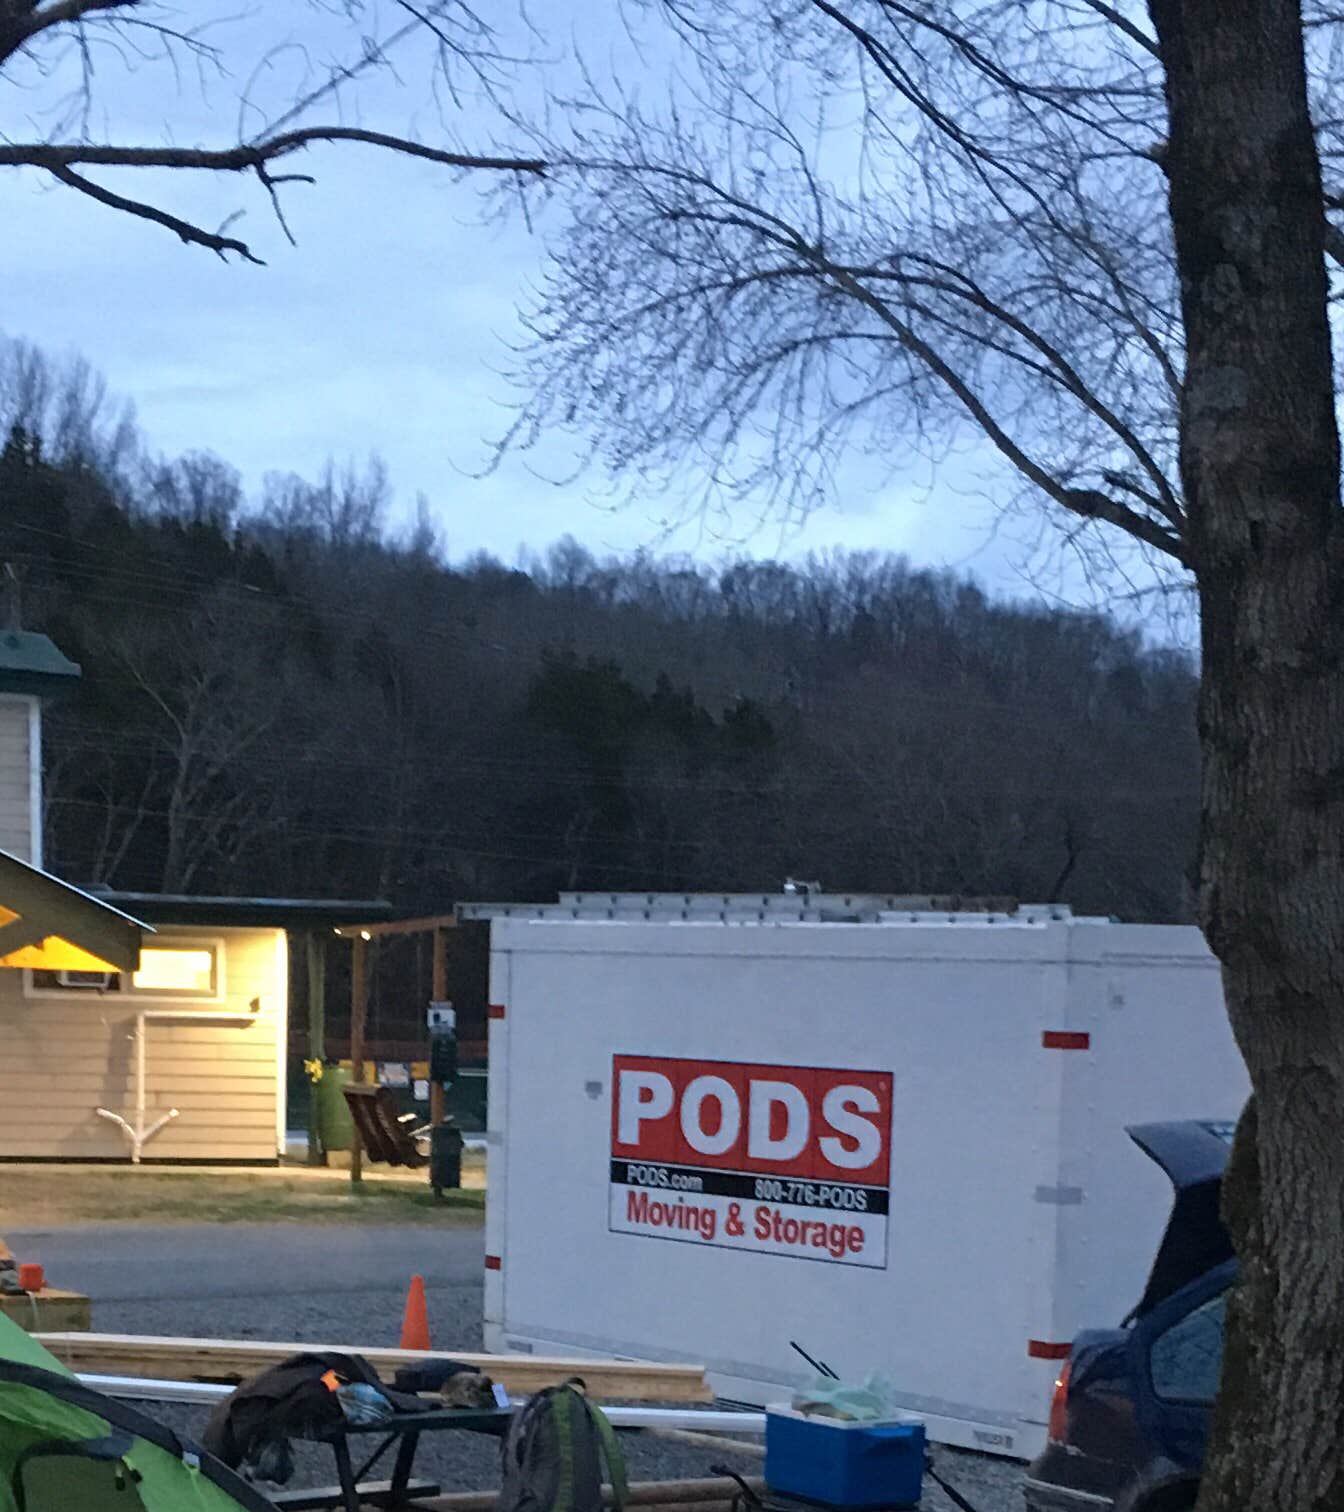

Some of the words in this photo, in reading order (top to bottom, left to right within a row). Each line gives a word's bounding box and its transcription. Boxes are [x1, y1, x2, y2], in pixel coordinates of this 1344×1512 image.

[617, 1069, 883, 1169] PODS
[626, 1164, 704, 1192] PODS.com
[626, 1190, 716, 1241] Moving
[724, 1202, 746, 1238] &
[753, 1205, 865, 1258] Storage
